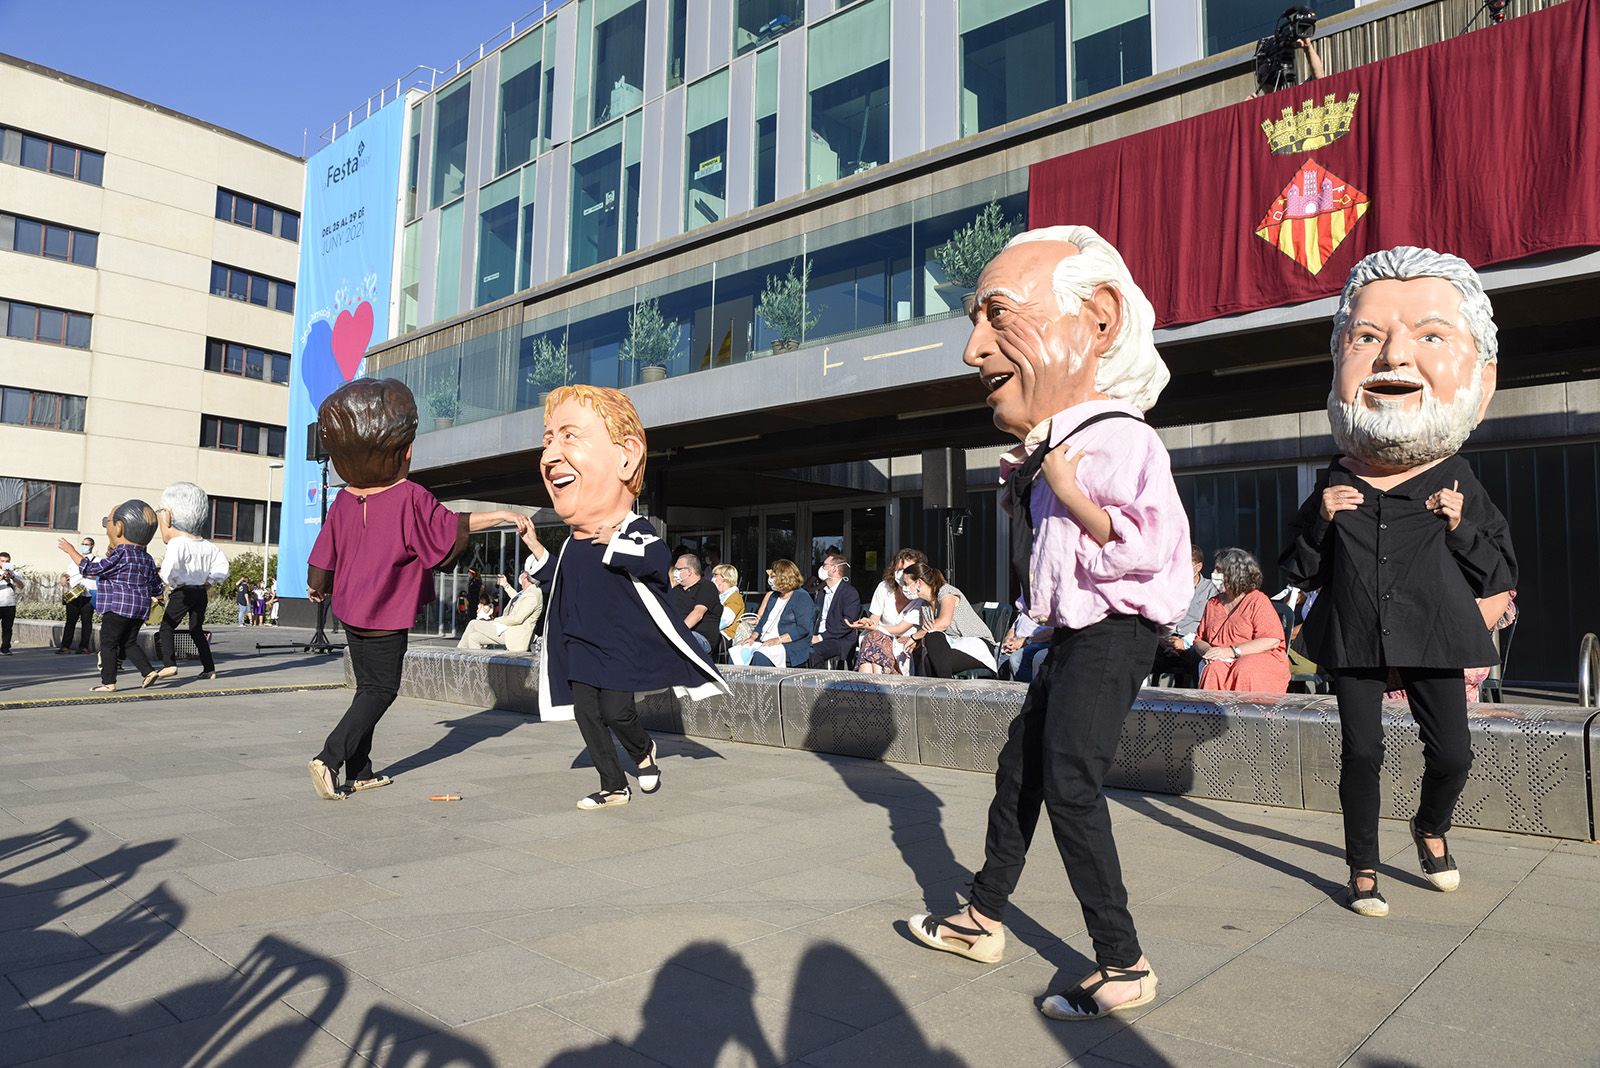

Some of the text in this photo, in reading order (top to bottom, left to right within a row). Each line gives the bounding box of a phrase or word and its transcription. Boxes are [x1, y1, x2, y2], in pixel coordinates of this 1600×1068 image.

[326, 156, 359, 188] Festa
[321, 226, 332, 238] DEL
[333, 221, 340, 232] 25
[340, 217, 348, 228] AL
[358, 206, 365, 219] DE
[321, 220, 365, 257] JUNY 2021
